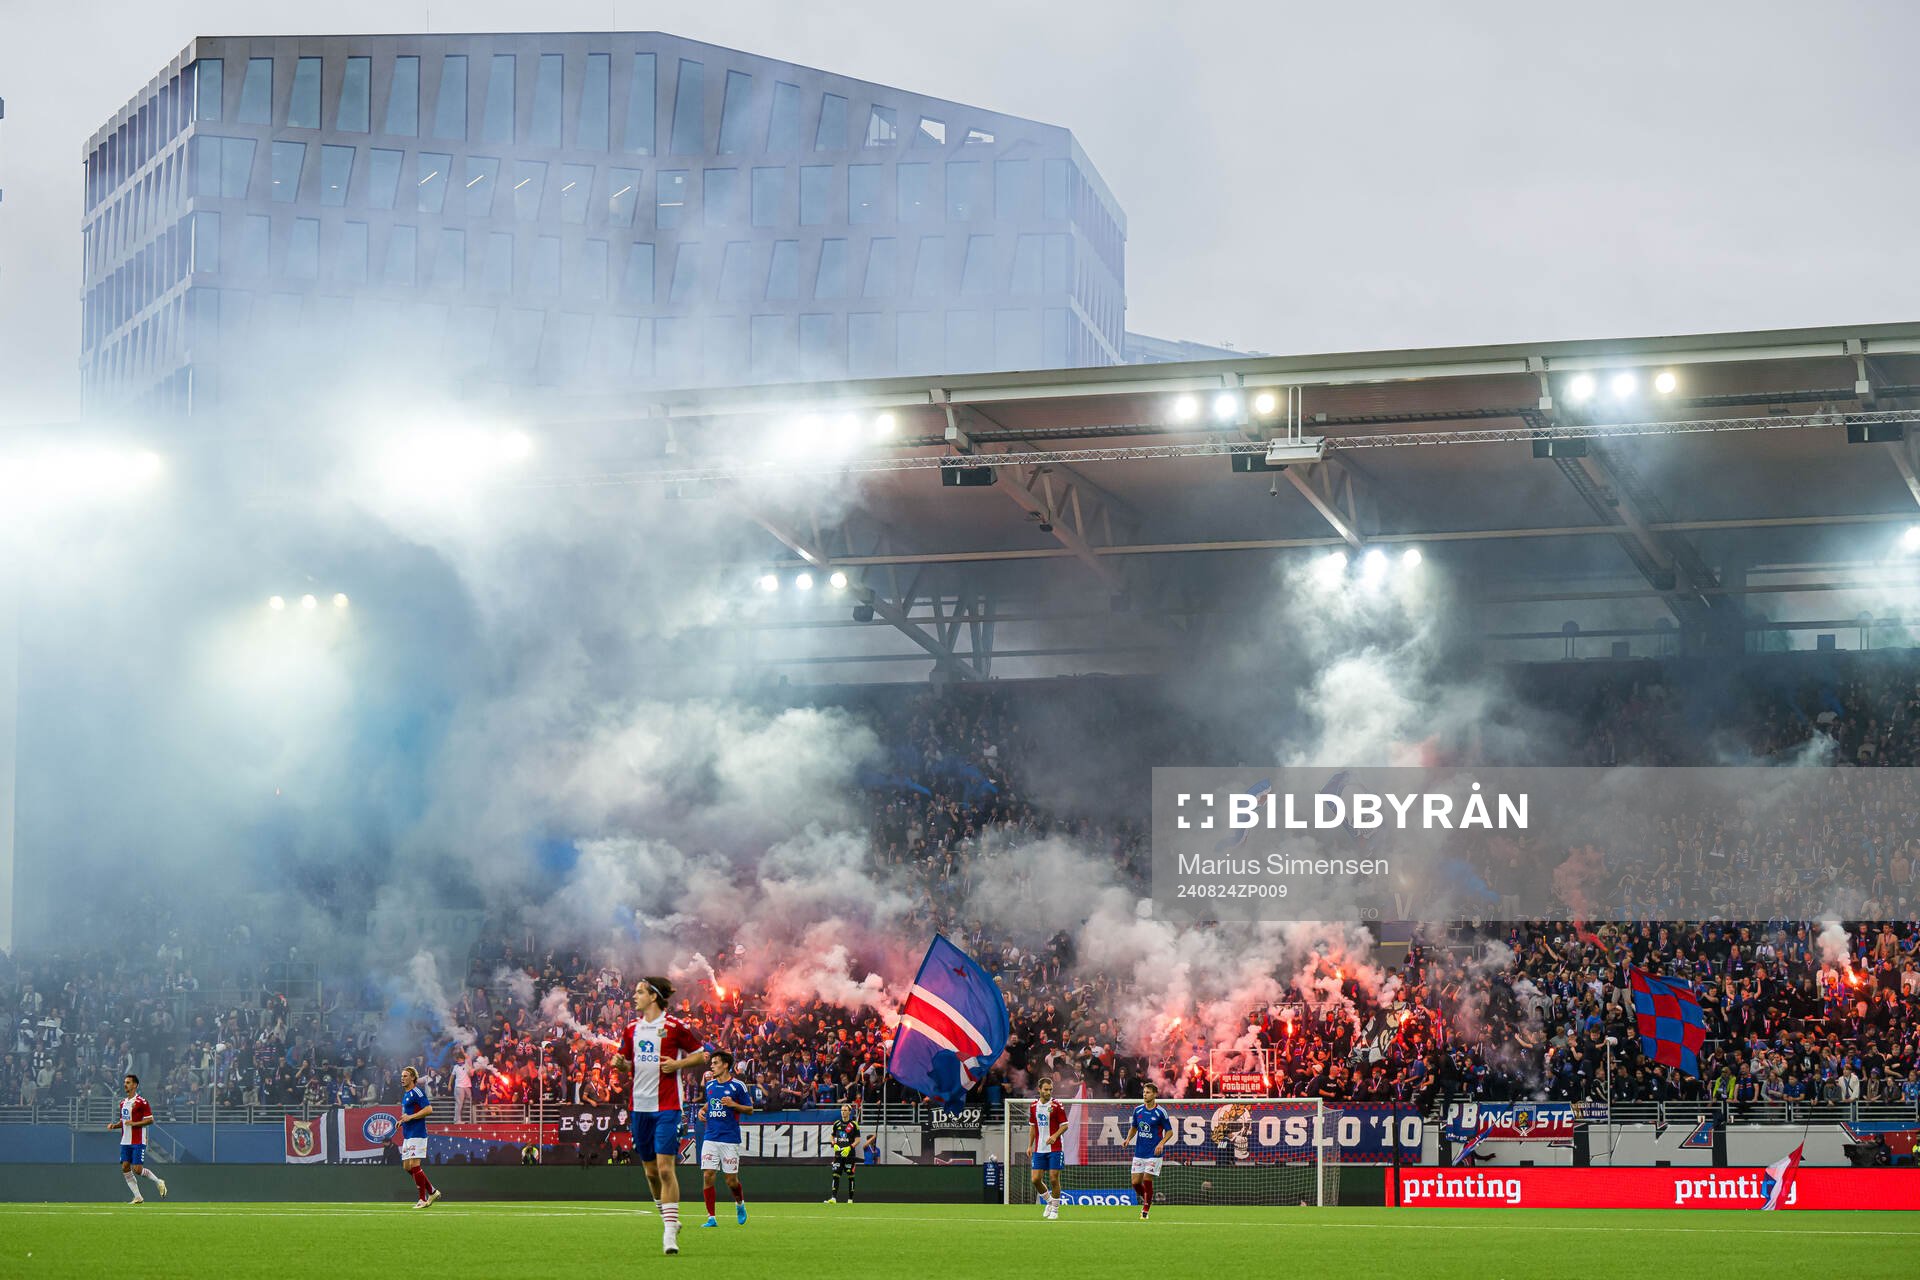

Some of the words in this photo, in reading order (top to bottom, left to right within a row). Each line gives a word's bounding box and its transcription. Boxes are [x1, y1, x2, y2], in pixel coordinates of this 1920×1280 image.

[1258, 1116, 1361, 1147] OSLO
[1078, 1195, 1132, 1206] OBOS
[1403, 1173, 1521, 1204] printing
